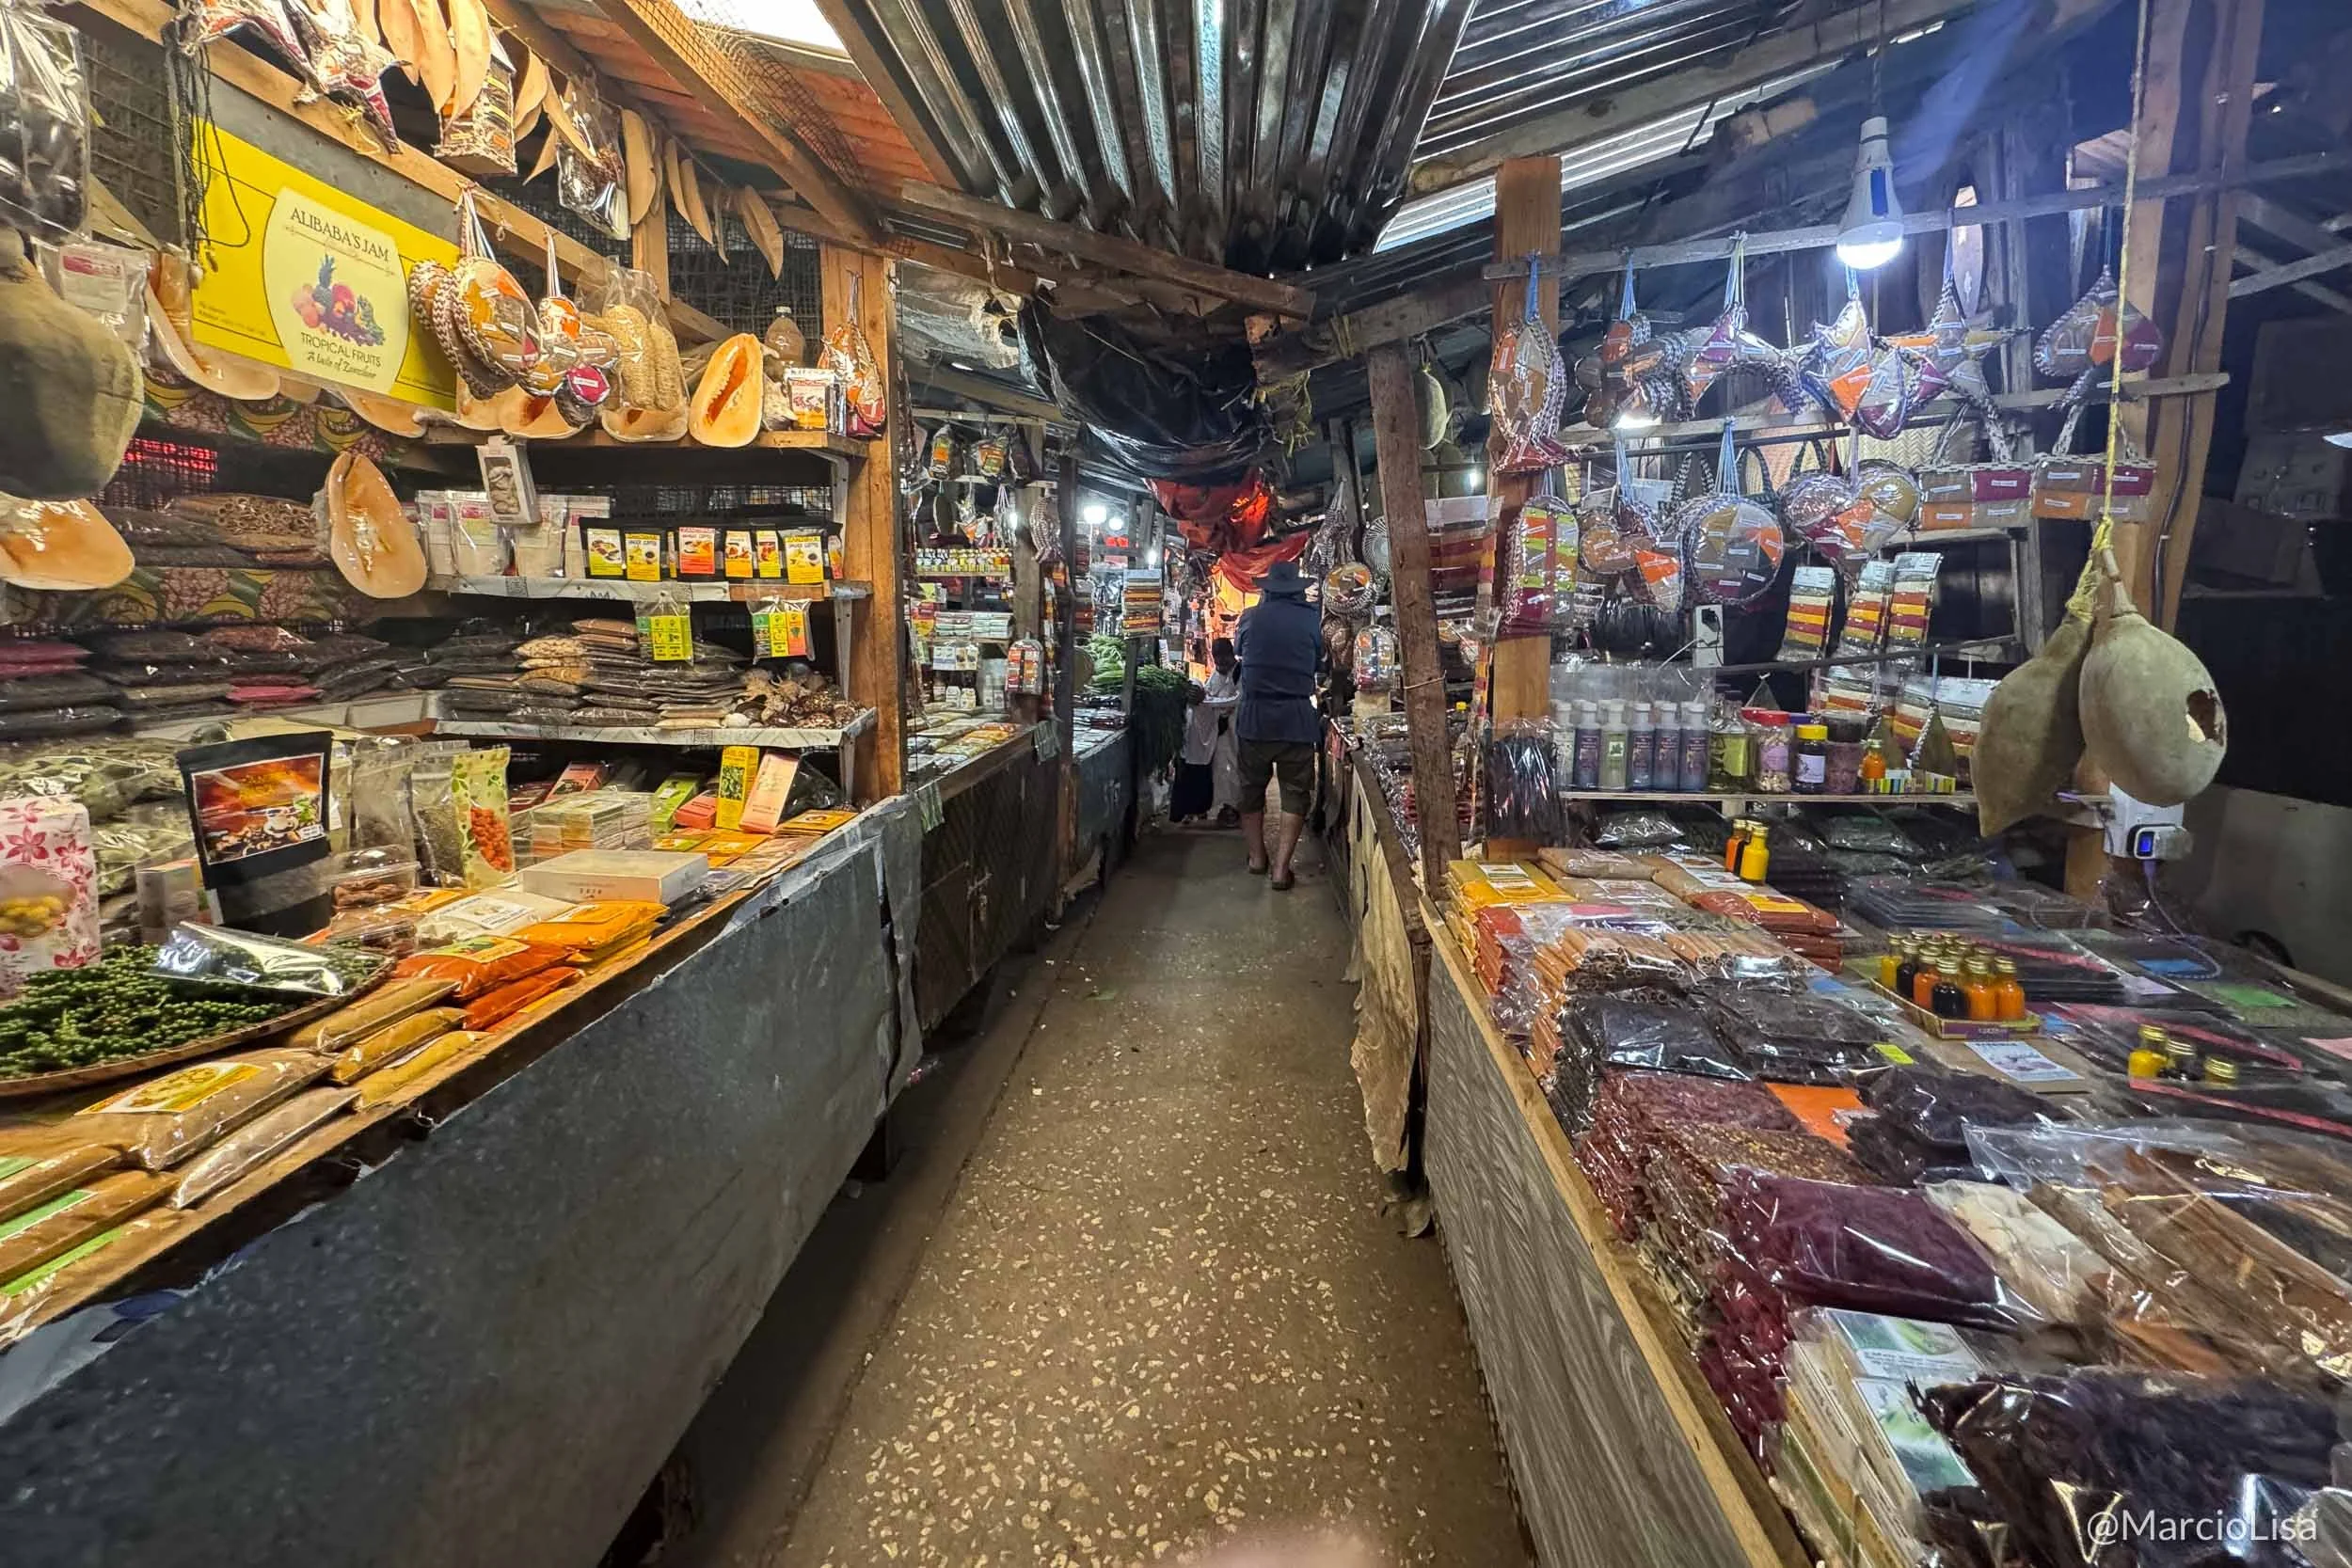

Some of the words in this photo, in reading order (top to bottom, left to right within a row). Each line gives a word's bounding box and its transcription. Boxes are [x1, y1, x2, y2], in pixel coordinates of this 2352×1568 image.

[290, 207, 361, 249] ALIBABA'S
[361, 239, 389, 261] JAM
[300, 332, 351, 358] TROPICAL
[352, 349, 382, 368] FRUITS
